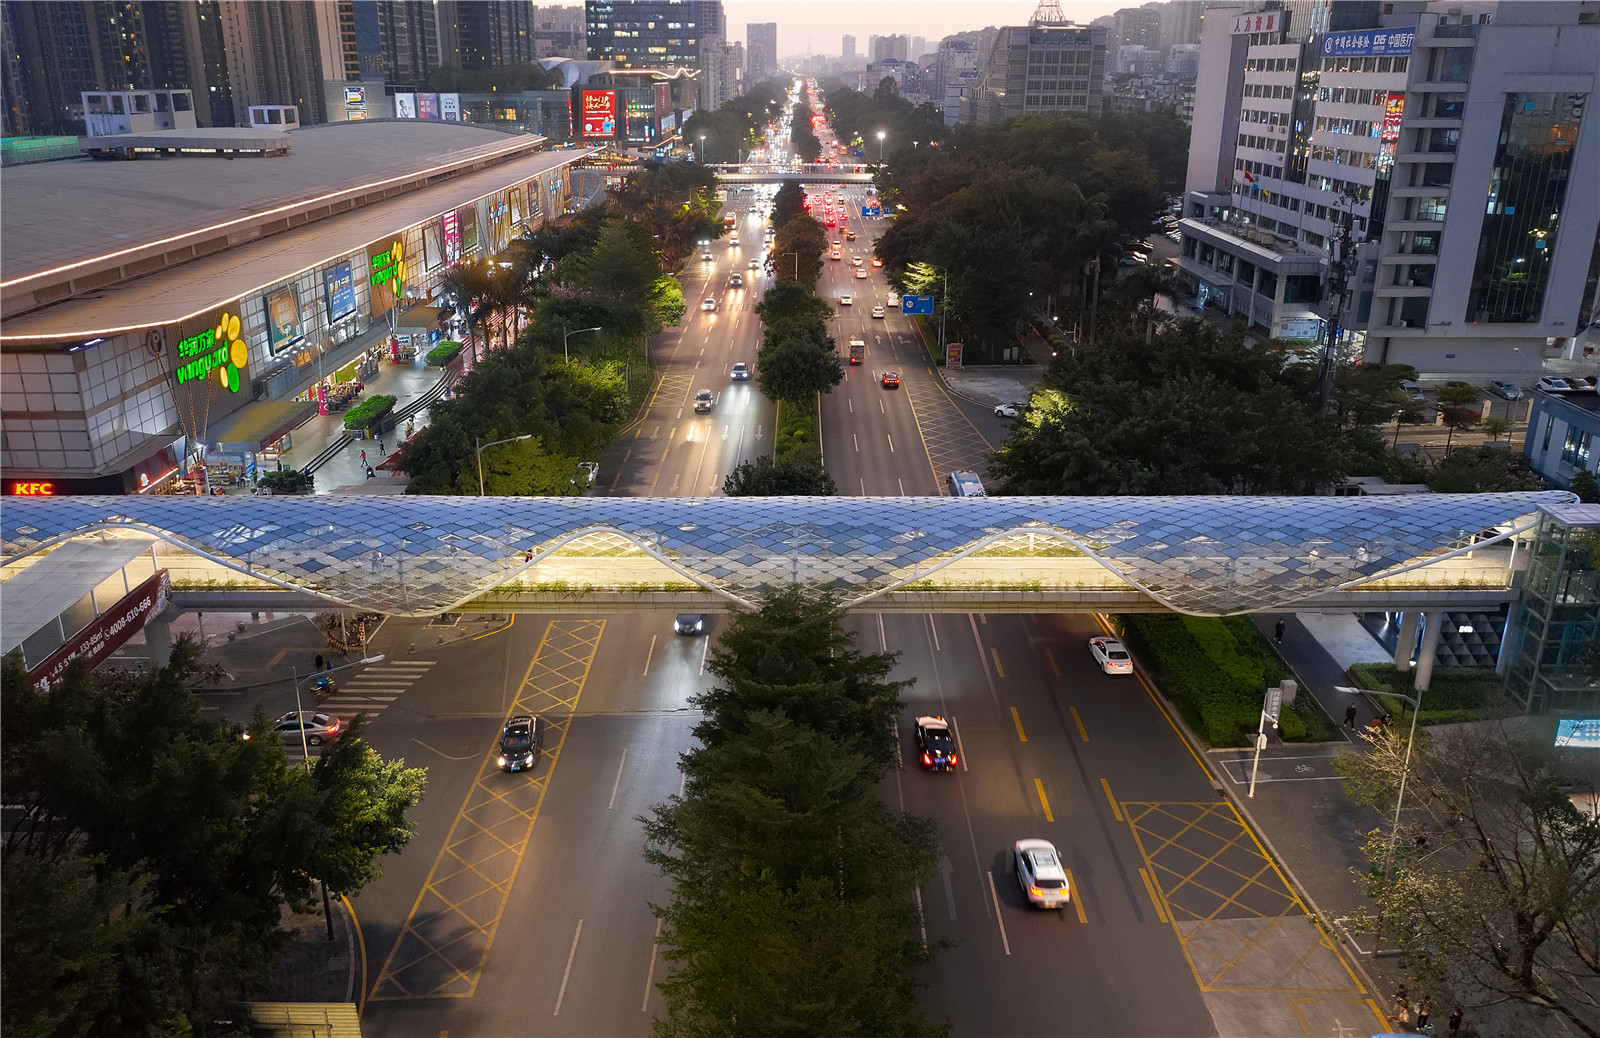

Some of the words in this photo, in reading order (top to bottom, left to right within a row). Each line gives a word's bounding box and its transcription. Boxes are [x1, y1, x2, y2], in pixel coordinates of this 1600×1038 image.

[1234, 14, 1275, 32] 人力资源
[178, 328, 215, 360] 华润万家
[176, 340, 229, 385] vanguard
[15, 483, 52, 495] KFC
[109, 596, 152, 636] 4008-610-666
